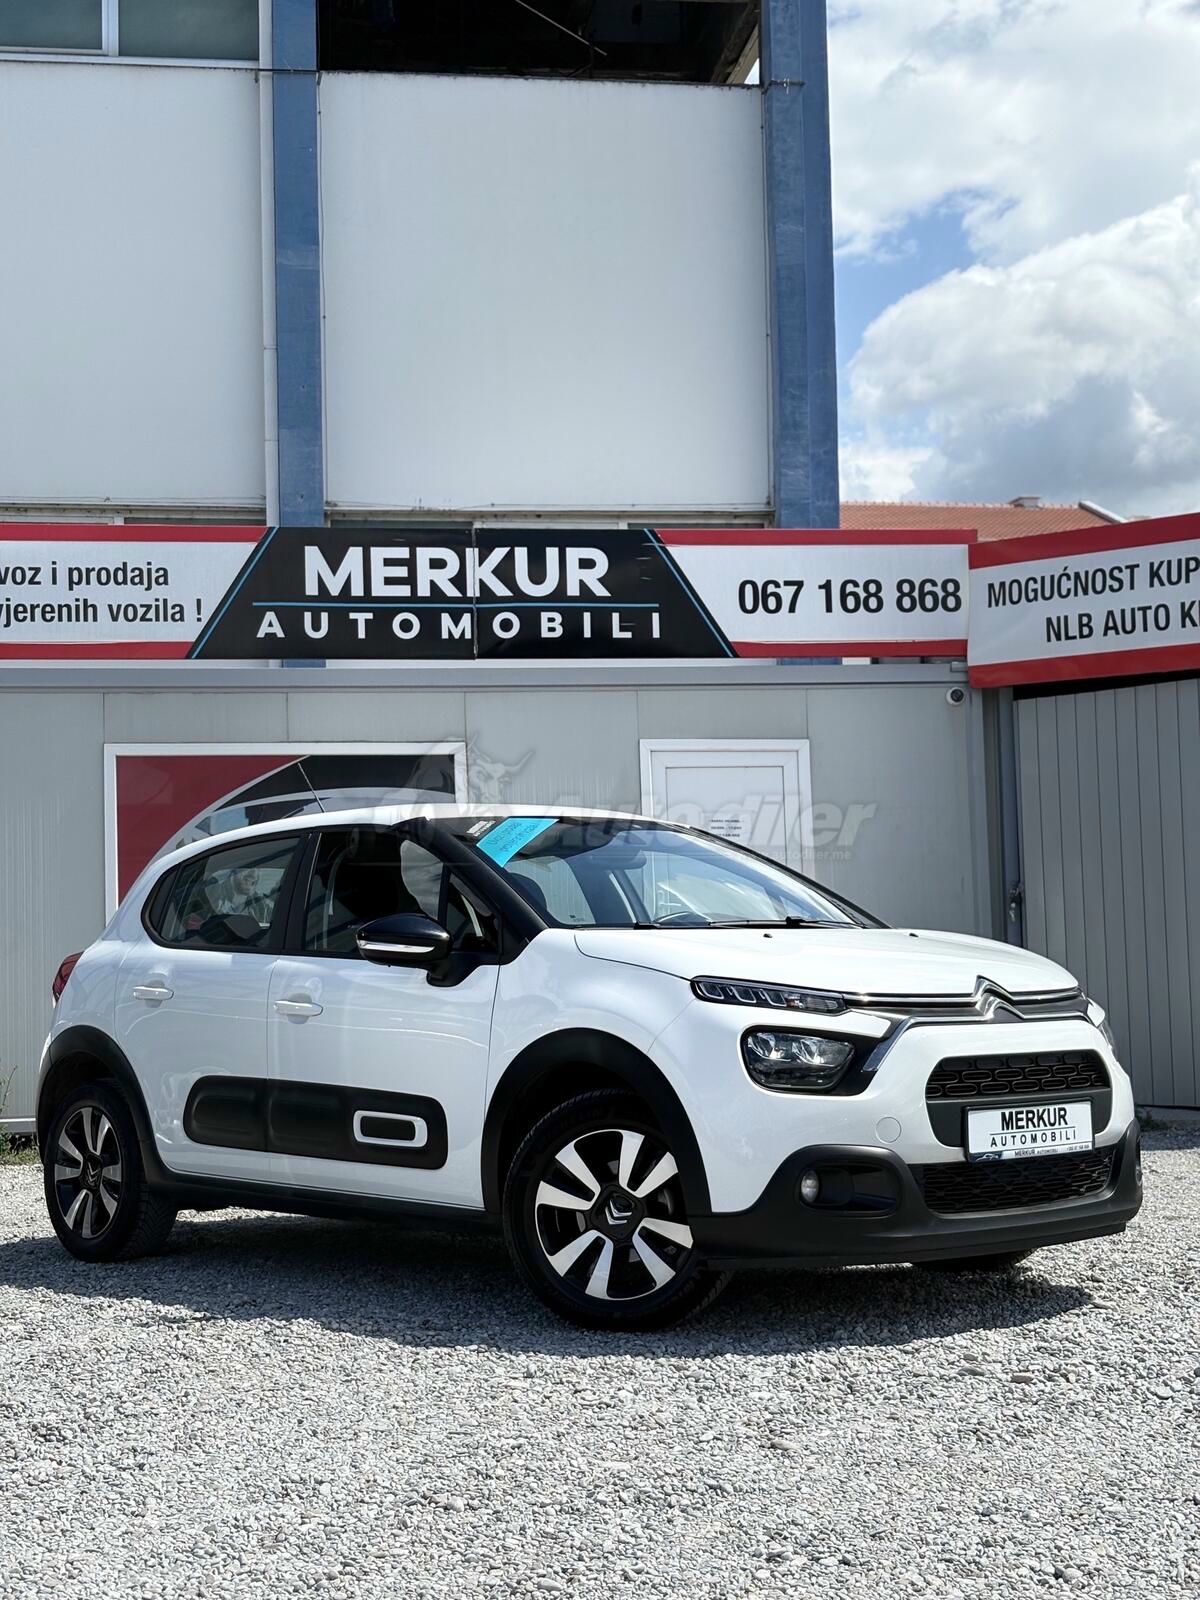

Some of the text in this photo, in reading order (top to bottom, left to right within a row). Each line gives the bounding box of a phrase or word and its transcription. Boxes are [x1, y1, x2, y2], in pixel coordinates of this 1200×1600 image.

[51, 561, 58, 586] i
[67, 561, 170, 591] prodaja
[303, 545, 611, 598] MERKUR
[987, 556, 1200, 608] MOGUĆNOST KUP
[107, 598, 186, 622] vozila
[195, 598, 203, 622] !
[737, 577, 963, 615] 067 168 868
[256, 610, 662, 640] AUTOMOBILI
[1045, 600, 1200, 643] NLB AUTO K
[1000, 1107, 1069, 1131] MERKUR
[990, 1128, 1077, 1148] AUTOMOBILI
